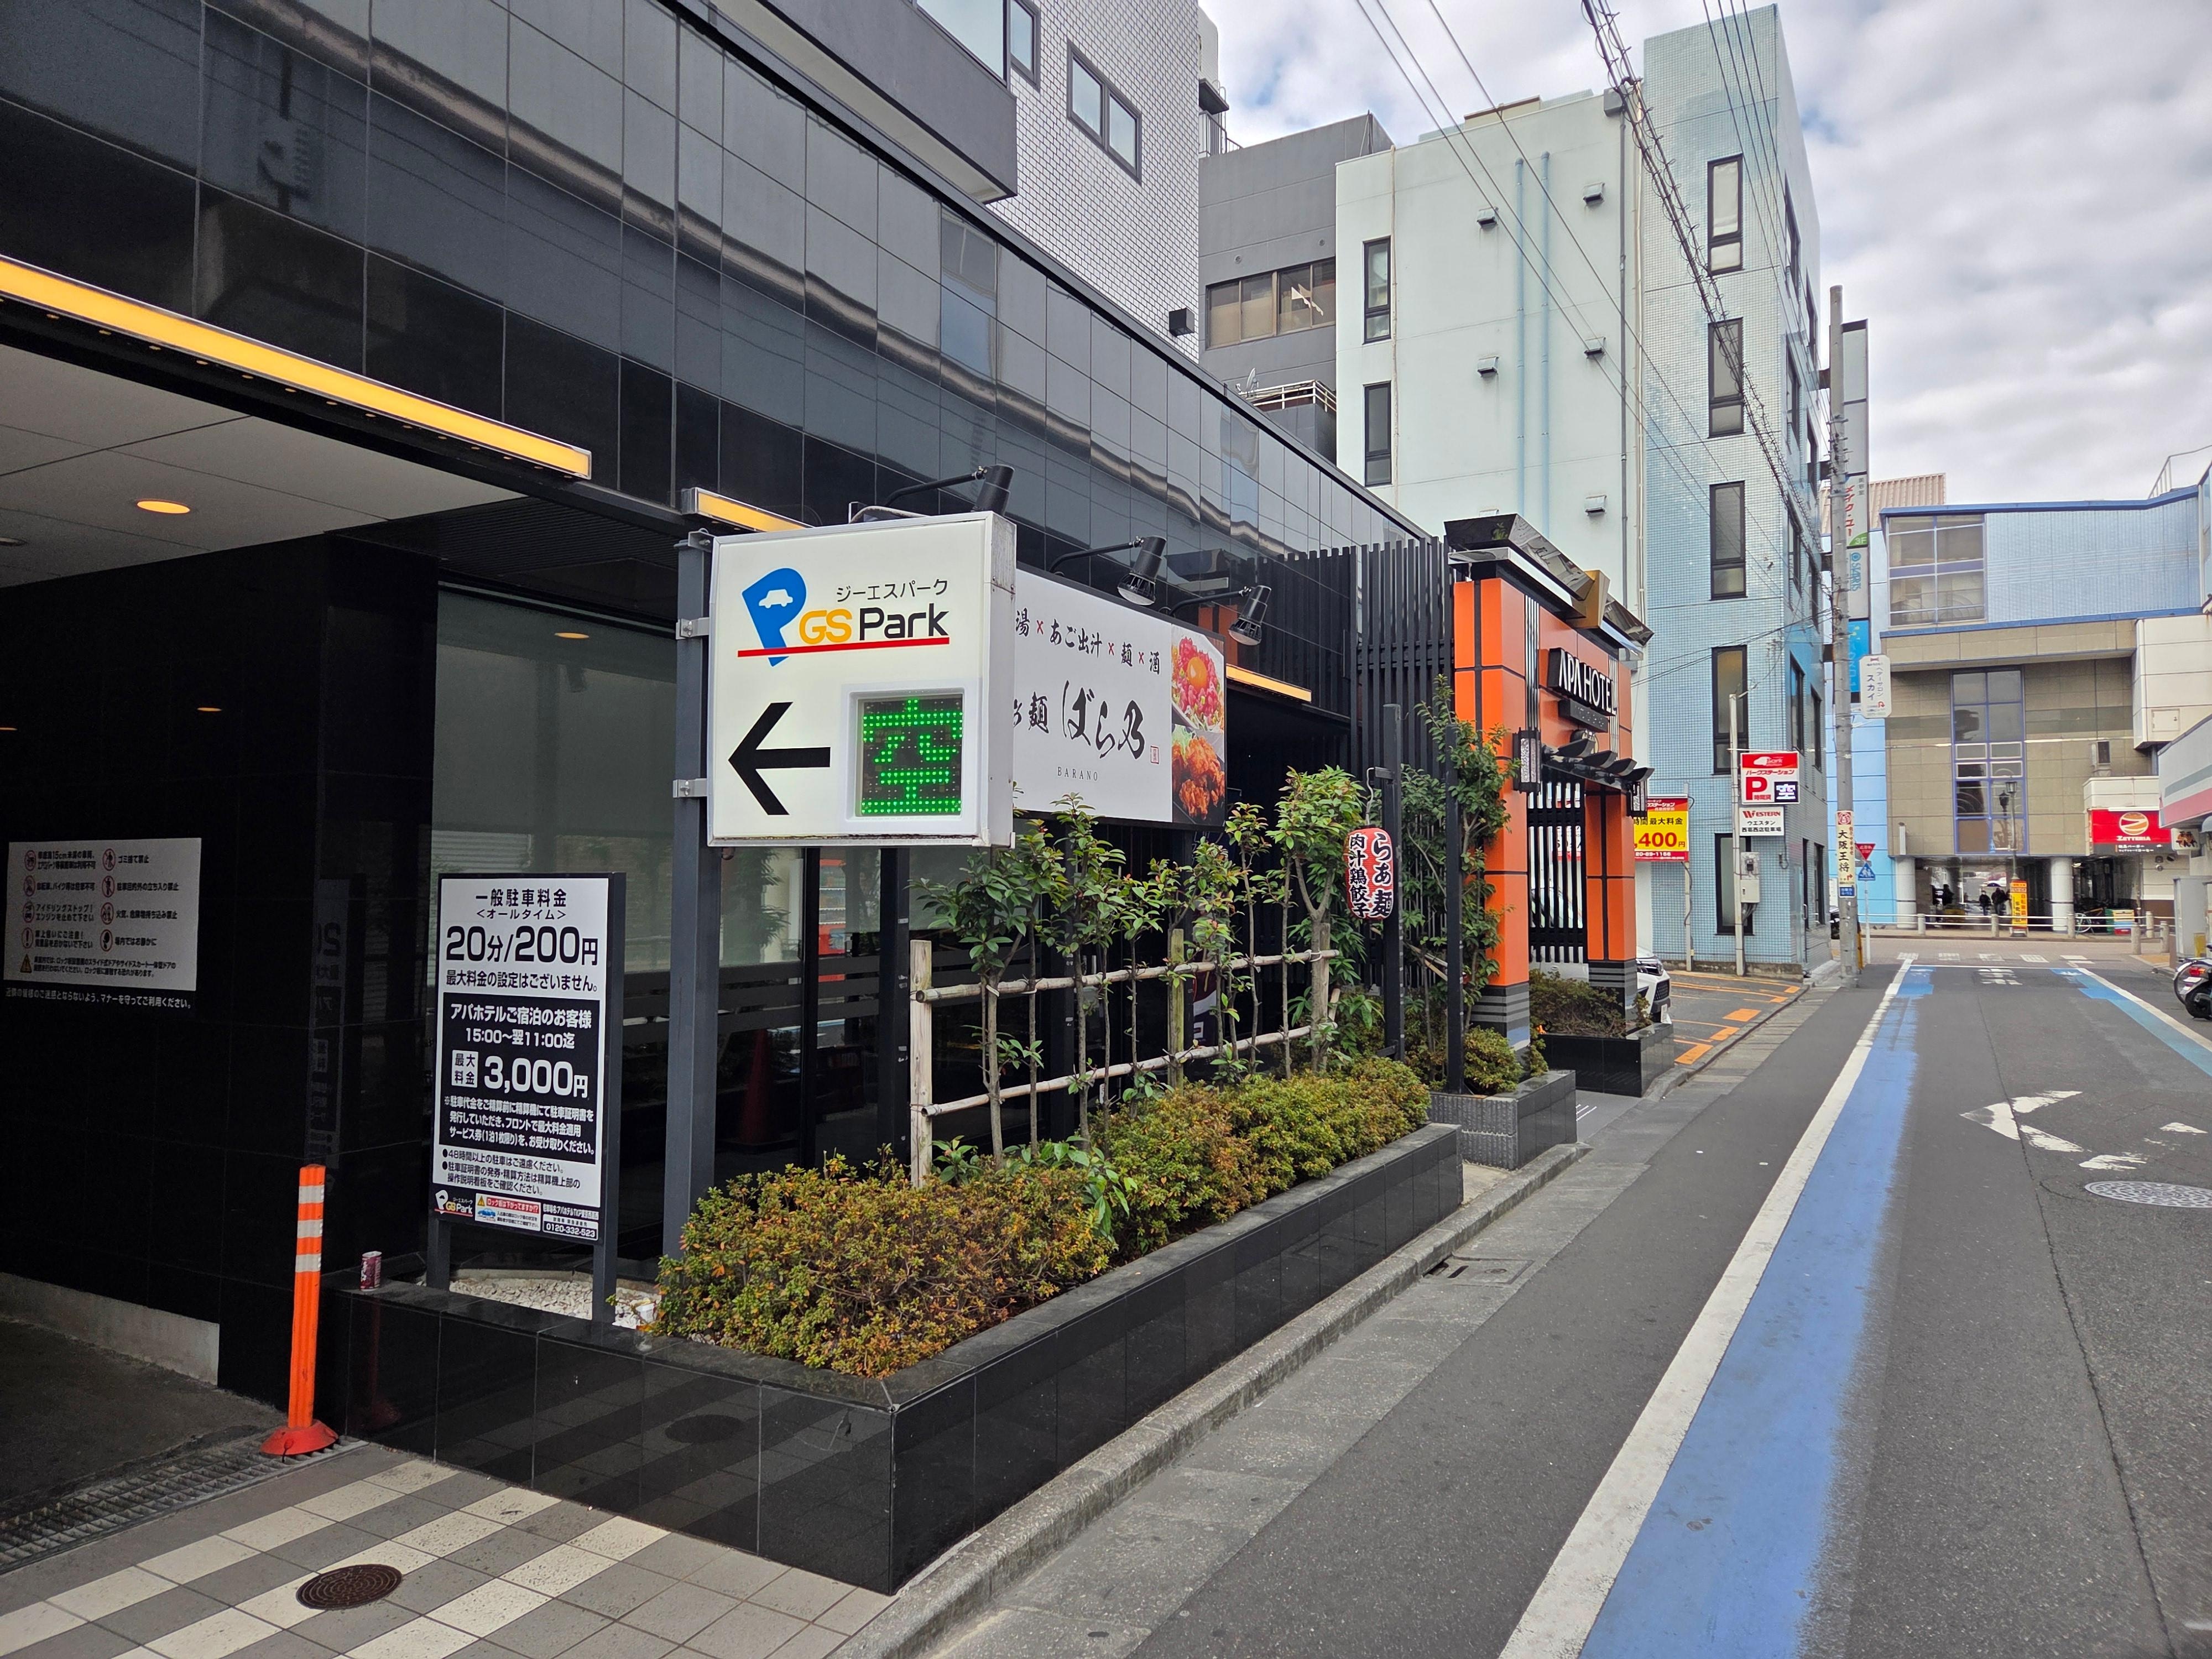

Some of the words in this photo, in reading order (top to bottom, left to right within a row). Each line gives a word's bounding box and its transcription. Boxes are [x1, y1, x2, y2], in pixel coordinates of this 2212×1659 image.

[837, 578, 948, 602] ジーエスパーク
[860, 603, 949, 641] Park
[1559, 649, 1582, 698] APA
[1583, 664, 1618, 714] HOTEL
[1867, 675, 1875, 701] スカイ
[1062, 680, 1145, 760] ばら乃
[862, 698, 963, 815] 空
[1057, 766, 1098, 781] BARANO
[1746, 777, 1767, 800] P
[1776, 784, 1796, 800] 空
[1838, 830, 1850, 873] 大阪王将
[1349, 834, 1370, 917] 肉汁鶏餃子
[476, 888, 567, 907] 一般駐車料金
[446, 925, 598, 966] 20分/200円
[446, 969, 598, 992] 最大料金の設定はございません。
[450, 1004, 592, 1029] アパホテルご宿泊のお客様
[455, 1053, 476, 1067] 最大
[454, 1070, 475, 1085] 料金
[484, 1055, 588, 1098] 3,000円
[456, 1203, 473, 1214] Park
[546, 1223, 596, 1238] 0120-332-523
